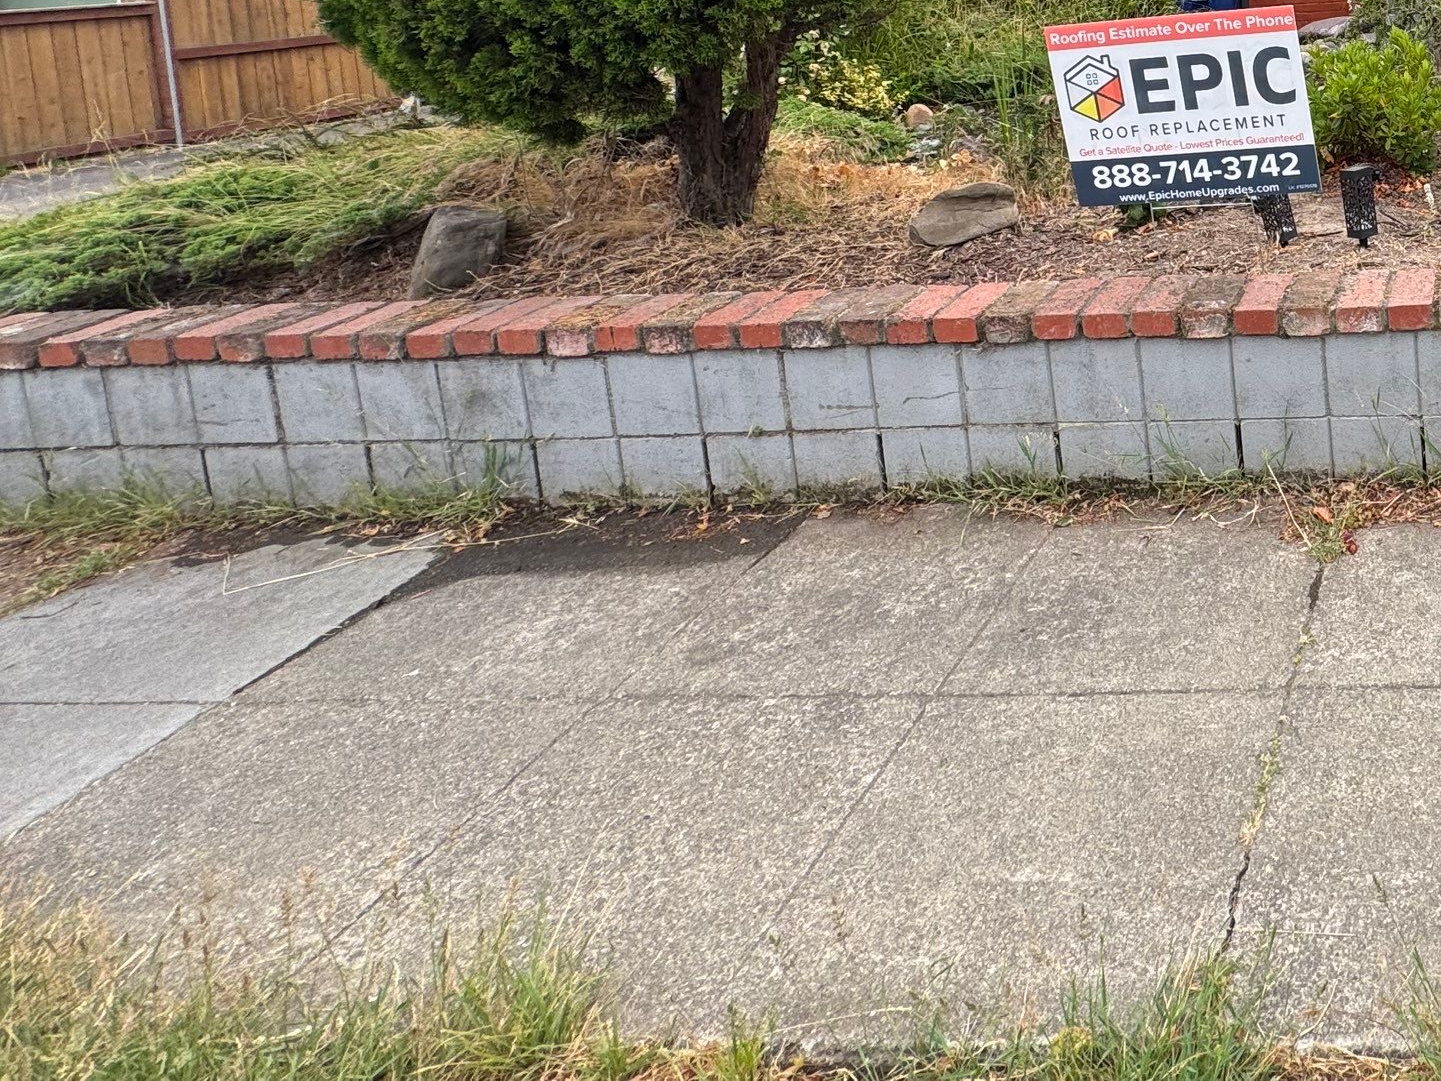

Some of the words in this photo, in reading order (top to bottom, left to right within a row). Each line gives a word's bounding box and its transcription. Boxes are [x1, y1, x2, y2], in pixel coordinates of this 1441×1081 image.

[1050, 29, 1105, 45] Roofing
[1109, 25, 1171, 40] Estimate
[1175, 21, 1210, 34] Over
[1214, 18, 1242, 31] The
[1245, 15, 1293, 28] Phone
[1129, 46, 1297, 114] EPIC
[1090, 125, 1140, 140] ROOF
[1149, 114, 1286, 136] REPLACEMENT
[1079, 148, 1096, 157] Get
[1106, 144, 1142, 155] Satellite
[1144, 143, 1173, 153] Quote
[1180, 139, 1213, 150] Lowest
[1215, 137, 1243, 147] Prices
[1246, 132, 1305, 144] Guaranteed!
[1092, 152, 1301, 189] 888-714-3742
[1119, 184, 1280, 202] www.EpicHomeUpgrades.com
